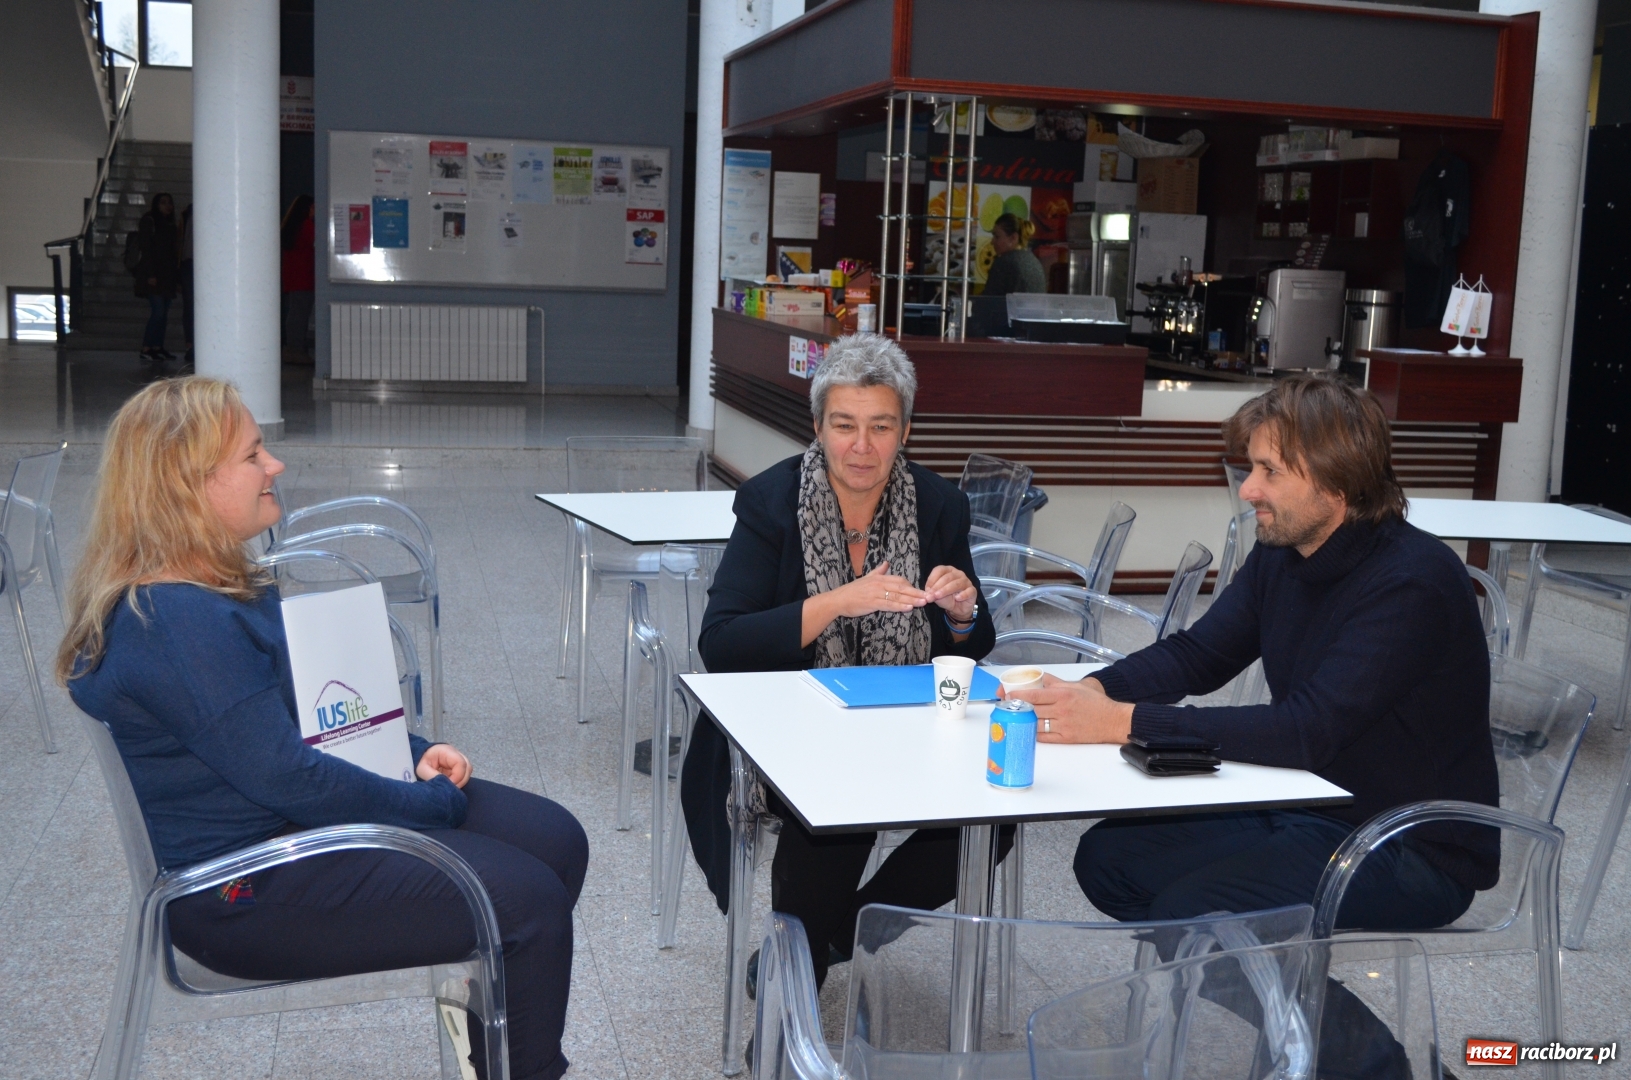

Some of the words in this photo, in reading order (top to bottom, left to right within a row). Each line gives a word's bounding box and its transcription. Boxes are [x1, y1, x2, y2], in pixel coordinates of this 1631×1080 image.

[636, 211, 655, 220] SAP
[321, 730, 341, 742] Lifelong
[340, 725, 359, 737] Learning
[358, 721, 371, 730] Center
[356, 731, 366, 739] future
